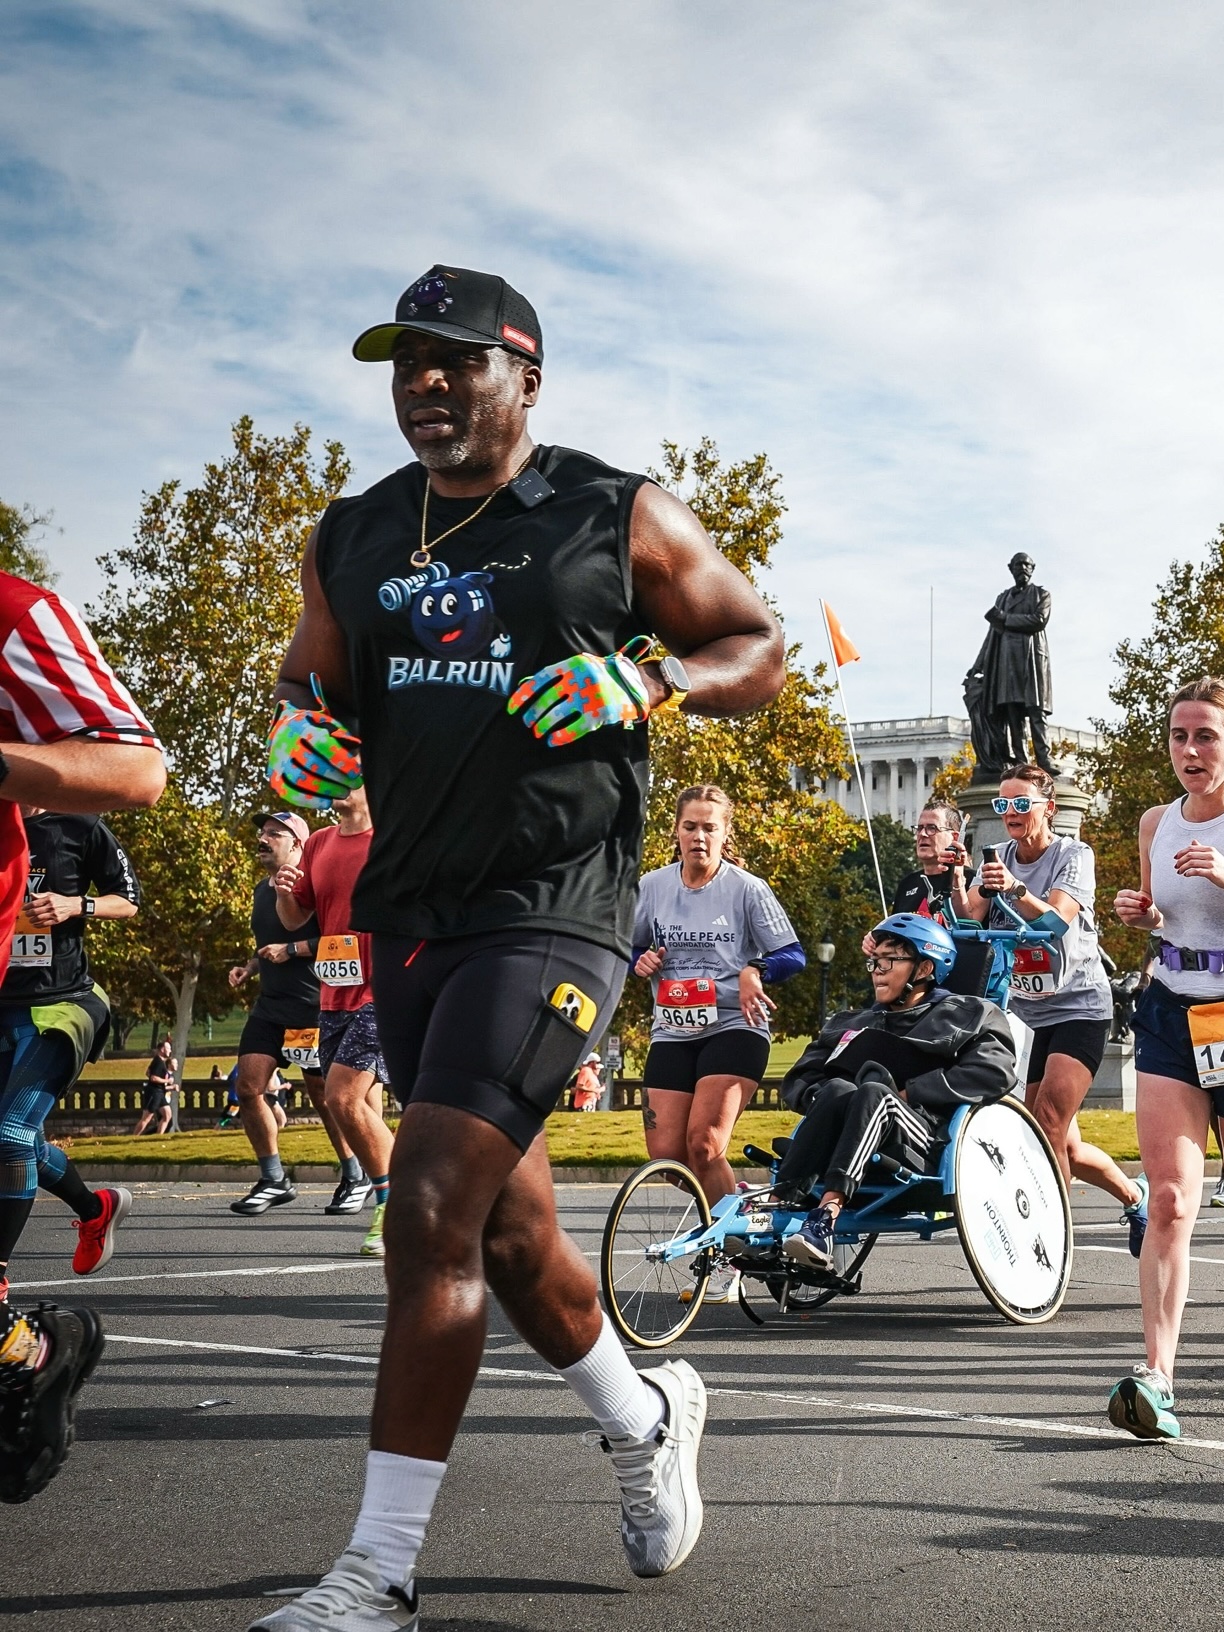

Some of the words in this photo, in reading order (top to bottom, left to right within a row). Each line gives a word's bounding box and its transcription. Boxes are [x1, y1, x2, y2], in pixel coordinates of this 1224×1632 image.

[388, 657, 515, 696] BALRUN
[668, 932, 696, 942] KYLE
[699, 932, 735, 942] PEASE
[316, 960, 358, 978] 12856
[662, 1008, 708, 1026] 9645
[984, 1201, 1017, 1268] THORNTON
